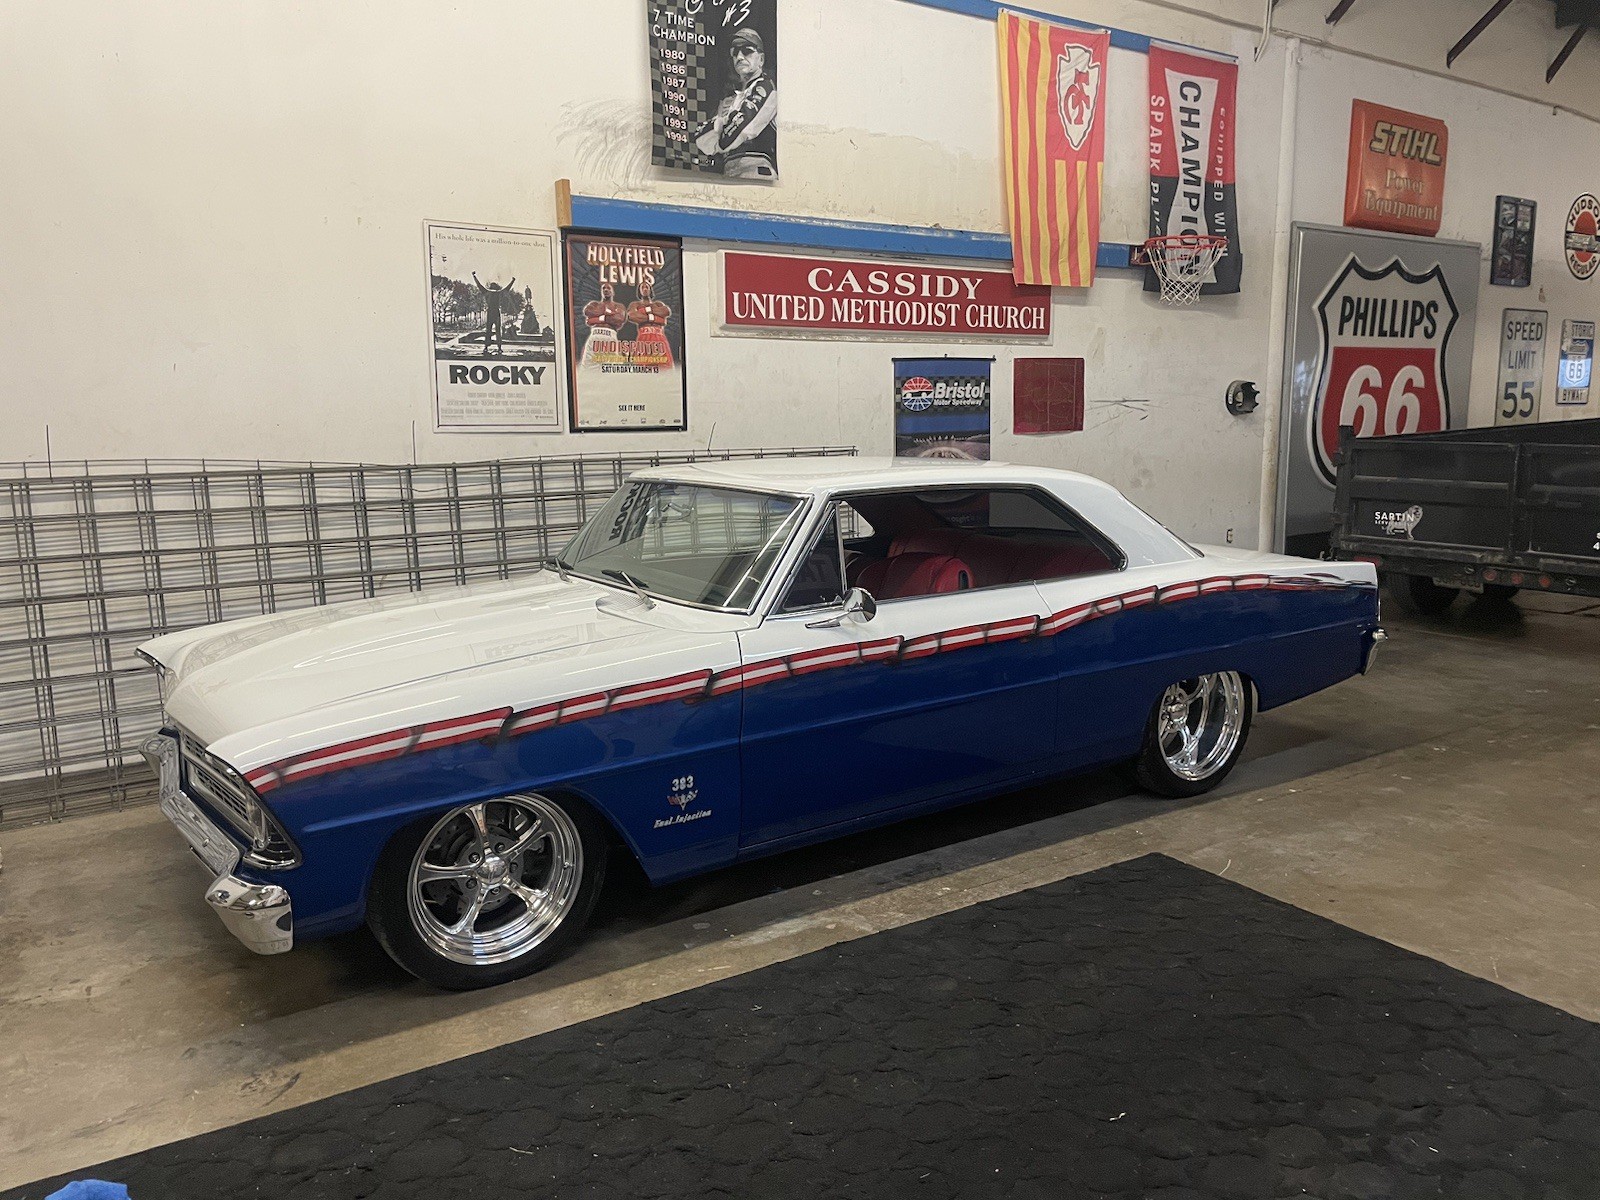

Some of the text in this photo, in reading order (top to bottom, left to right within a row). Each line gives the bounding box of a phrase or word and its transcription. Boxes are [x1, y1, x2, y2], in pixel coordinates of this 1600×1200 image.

[653, 9, 694, 28] 7 TIME
[652, 24, 716, 46] CHAMPION
[660, 48, 685, 60] 1980
[661, 62, 686, 75] 1986
[662, 76, 686, 89] 1987
[663, 90, 686, 103] 1990
[664, 104, 685, 116] 1991
[665, 116, 687, 130] 1993
[1150, 94, 1165, 171] SPARK
[666, 130, 688, 143] 1994
[1369, 120, 1442, 166] STIHL
[1386, 168, 1425, 194] Power
[1364, 188, 1438, 220] Equipment
[448, 234, 464, 242] whole
[588, 245, 664, 268] HOLYFIELD
[600, 266, 655, 286] LEWIS
[808, 268, 982, 300] CASSIDY
[732, 292, 1046, 330] UNITED METHODIST CHURCH
[1338, 296, 1438, 339] PHILLIPS
[1506, 320, 1542, 342] SPEED
[592, 340, 666, 354] UNDISPUTED
[1508, 350, 1537, 370] LIMIT
[450, 365, 546, 384] ROCKY
[632, 366, 652, 374] MARCH
[1569, 363, 1582, 379] 66
[934, 382, 986, 399] Bristol
[1502, 381, 1535, 418] 55
[618, 404, 627, 412] SEE
[634, 404, 646, 412] HERE
[934, 398, 983, 406] Motor Speedway
[1340, 364, 1426, 438] 66
[1374, 511, 1415, 522] SARTIN
[672, 775, 694, 792] 383
[653, 810, 712, 829] Fuel Injection
